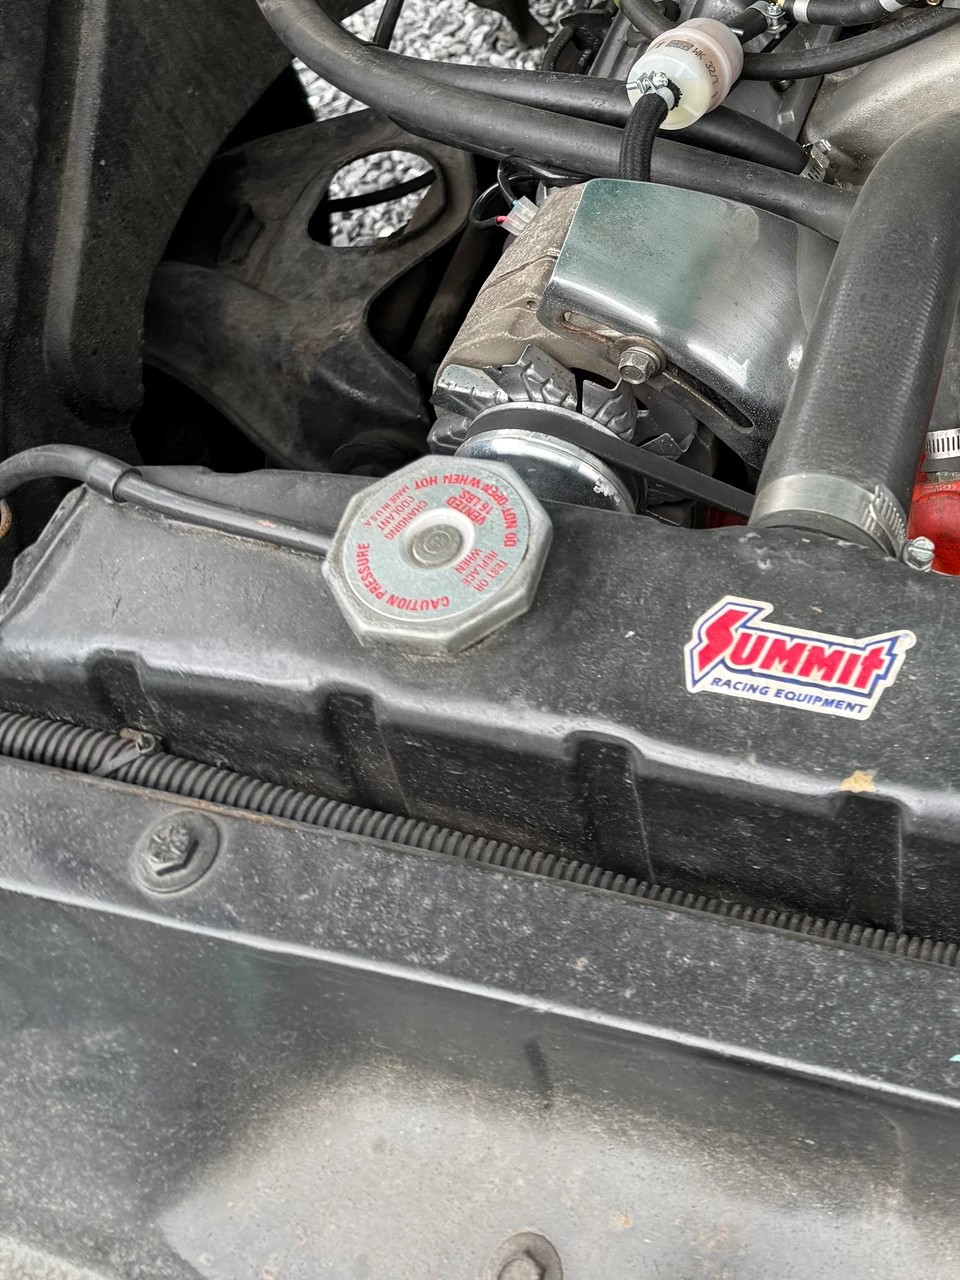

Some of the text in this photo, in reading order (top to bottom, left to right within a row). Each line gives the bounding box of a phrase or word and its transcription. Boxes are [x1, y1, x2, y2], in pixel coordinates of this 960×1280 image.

[380, 501, 391, 511] IN
[389, 484, 410, 504] MADE
[414, 474, 518, 548] DO NOT OPEN WHEN HOT
[445, 495, 487, 527] VENTED
[479, 501, 493, 516] 16
[376, 495, 415, 532] COOLANT
[384, 500, 428, 541] CHANGING
[356, 543, 450, 611] CAUTION PRESSURE
[454, 548, 484, 574] WHEN
[461, 549, 499, 587] REPLACE
[472, 559, 509, 592] TEST OR
[710, 676, 868, 714] RACING EQUIPMENT
